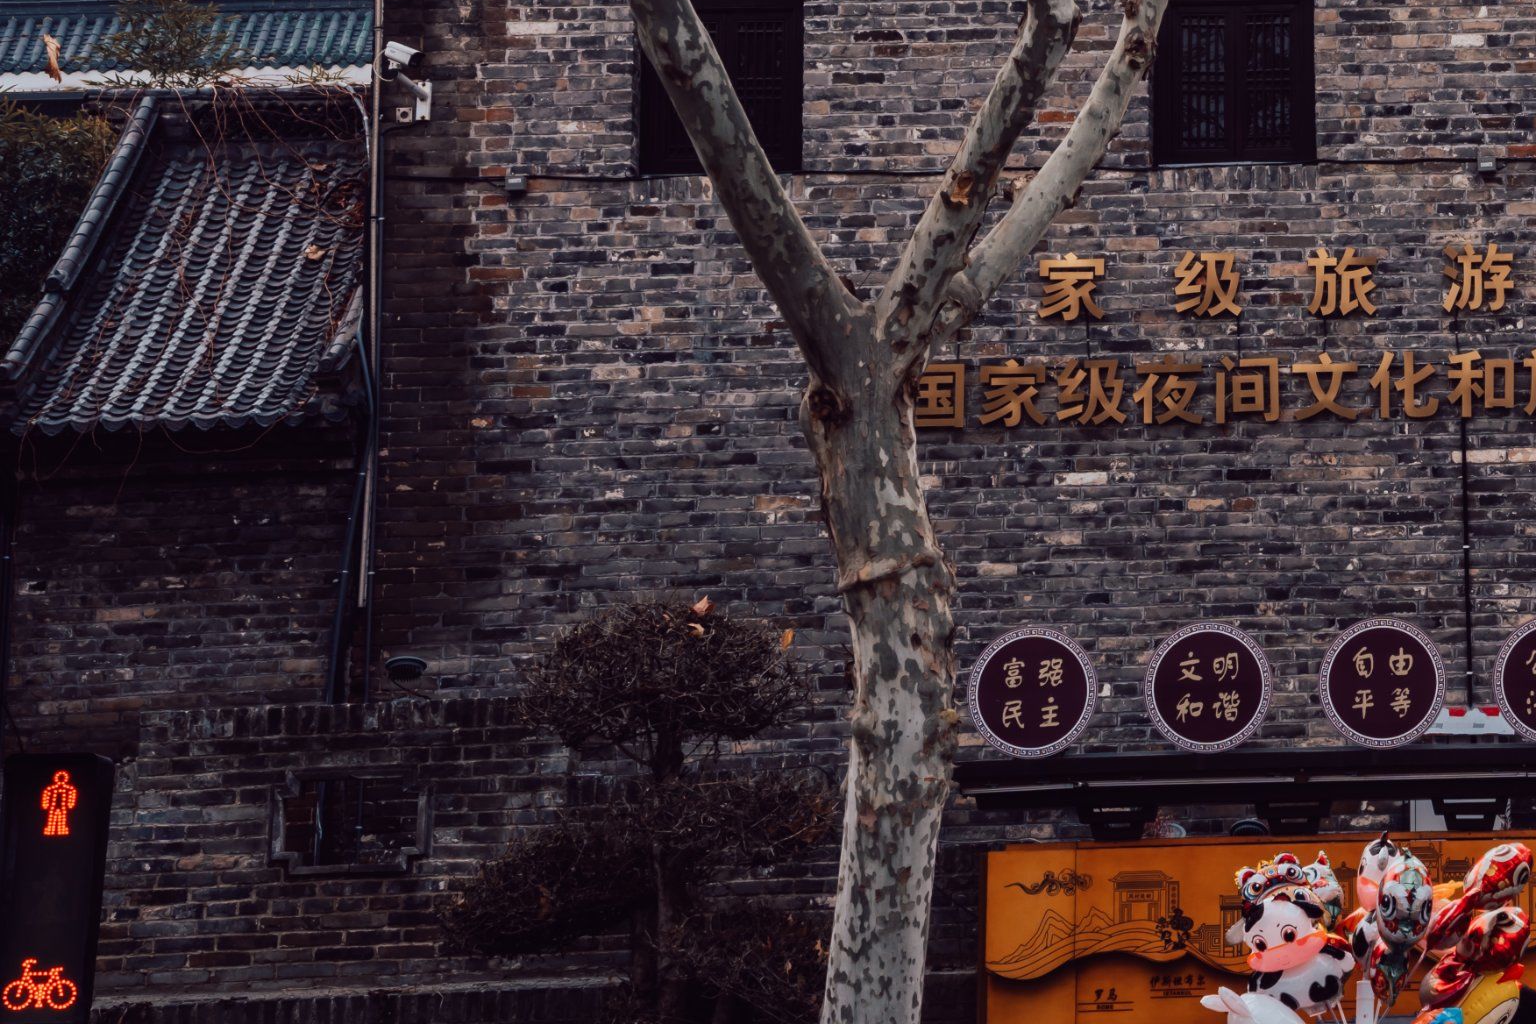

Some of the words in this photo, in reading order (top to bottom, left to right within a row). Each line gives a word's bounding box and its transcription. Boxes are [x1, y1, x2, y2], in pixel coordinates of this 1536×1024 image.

[1003, 657, 1063, 688] 富强
[1177, 651, 1239, 682] 文明
[1352, 646, 1413, 678] 自由
[1002, 696, 1060, 729] 民主
[1176, 690, 1240, 723] 和谐
[1351, 687, 1411, 720] 平等
